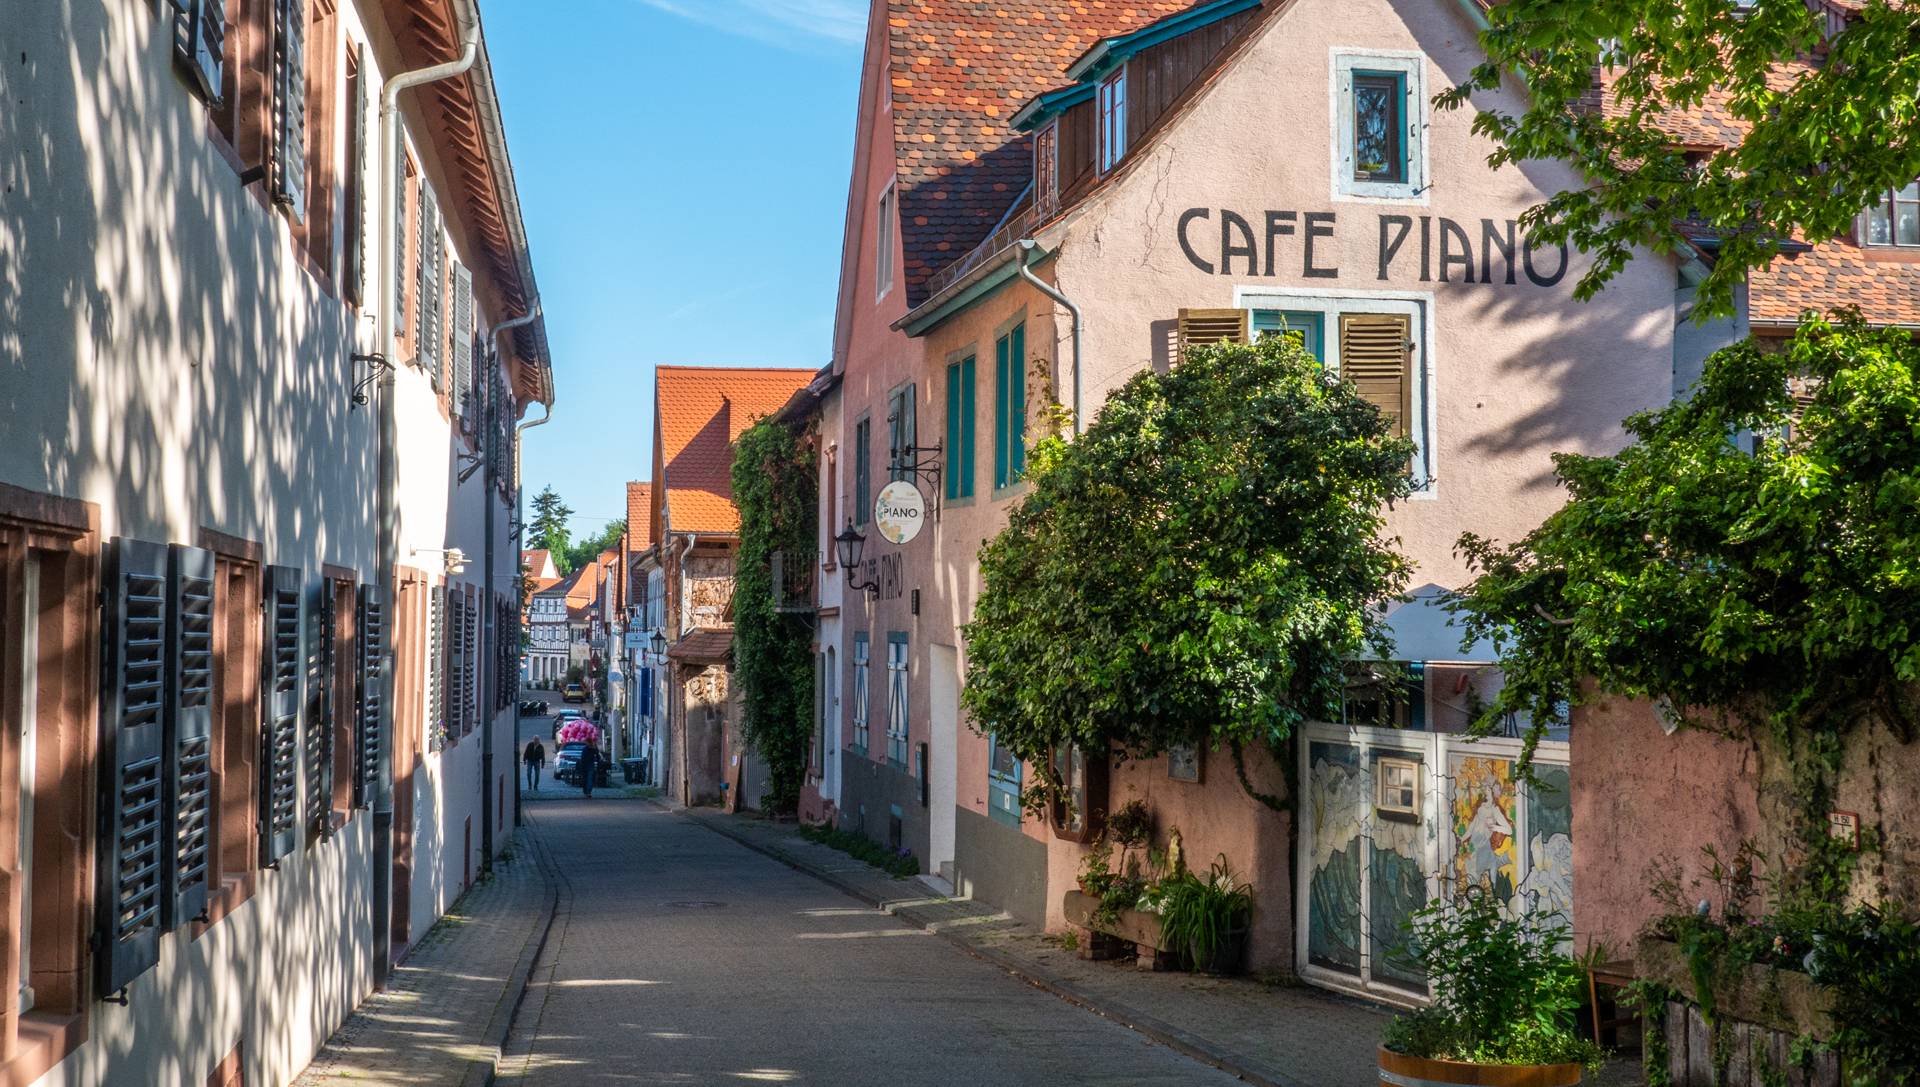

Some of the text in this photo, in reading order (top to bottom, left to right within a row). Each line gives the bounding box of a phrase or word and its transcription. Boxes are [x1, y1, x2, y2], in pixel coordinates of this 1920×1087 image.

[1177, 207, 1569, 288] CAFE PIANO
[883, 507, 918, 518] PIANO
[881, 552, 903, 600] PIANO
